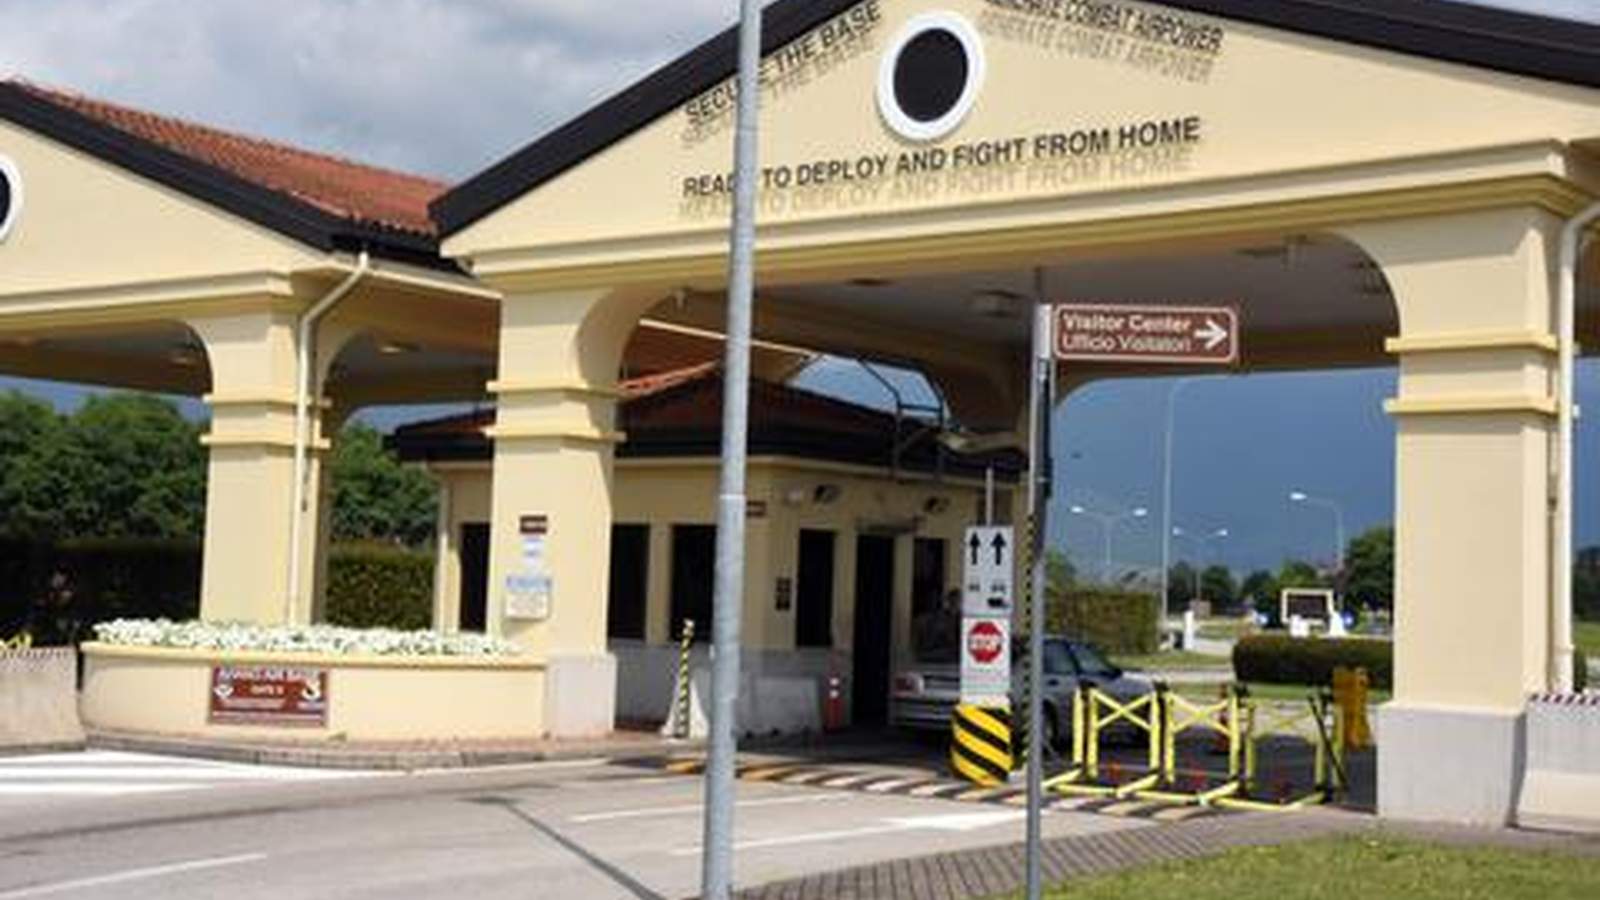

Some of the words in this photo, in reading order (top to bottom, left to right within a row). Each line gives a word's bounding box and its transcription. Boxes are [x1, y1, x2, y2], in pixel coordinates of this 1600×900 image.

[685, 62, 769, 121] SECUE
[773, 36, 814, 72] THE
[820, 1, 882, 48] BASE
[683, 173, 738, 198] READ
[762, 167, 791, 190] TO
[797, 153, 888, 185] DEPLOY
[896, 147, 946, 174] AND
[953, 138, 1026, 167] FIGHT
[1034, 129, 1110, 157] FROM
[1119, 117, 1200, 147] HOME
[1063, 313, 1125, 331] Visitor
[1129, 315, 1192, 333] Center
